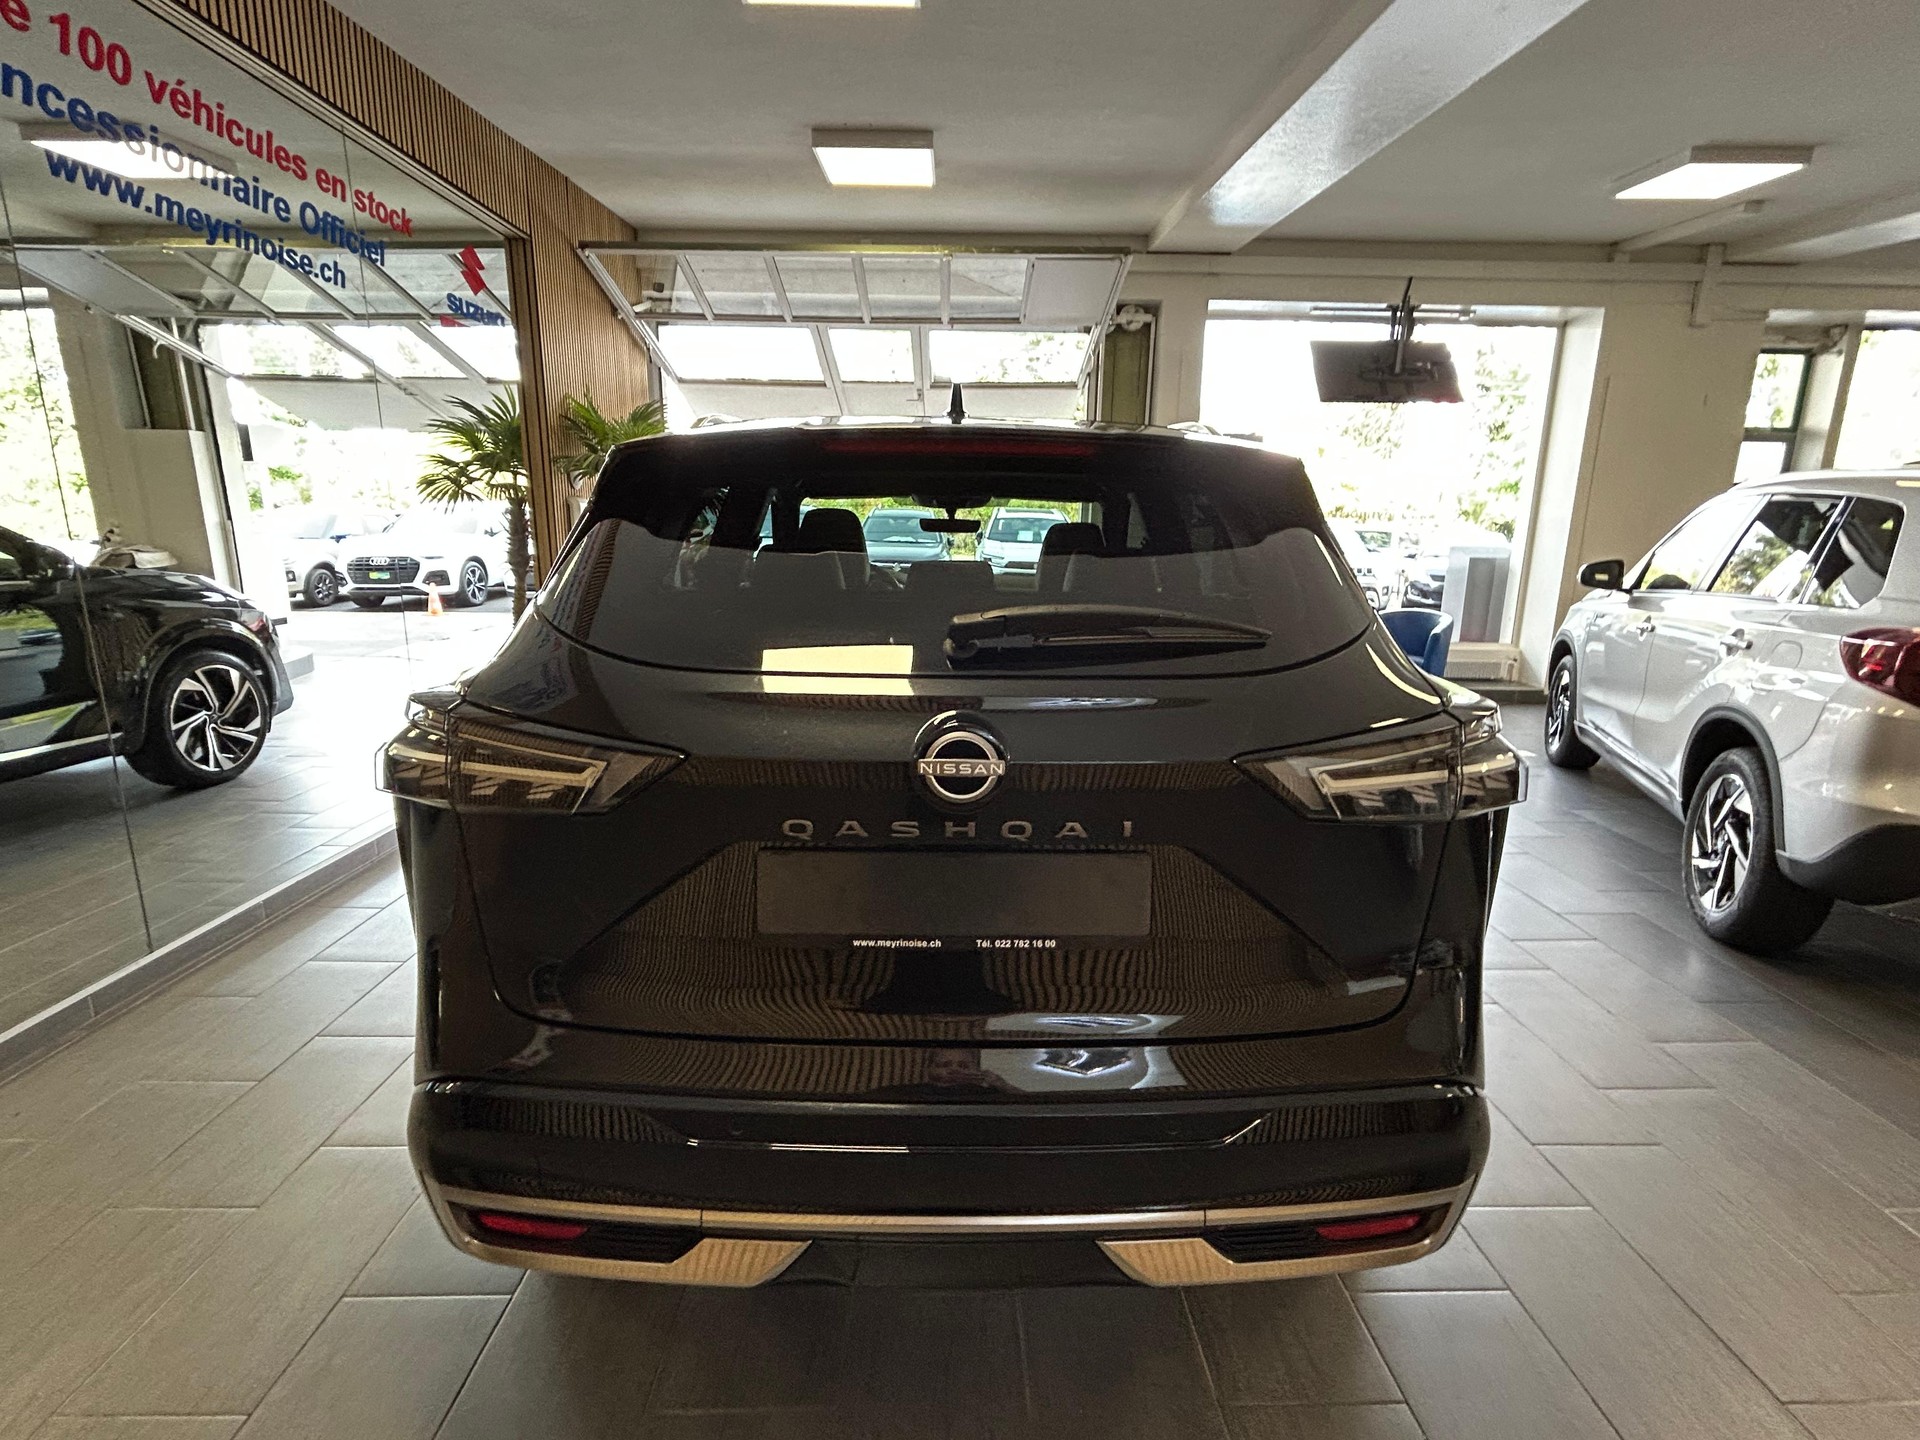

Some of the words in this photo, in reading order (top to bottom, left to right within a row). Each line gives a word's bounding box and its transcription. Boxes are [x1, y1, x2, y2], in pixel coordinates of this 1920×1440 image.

[49, 13, 132, 86] 100
[144, 70, 307, 181] véhicules
[315, 167, 346, 202] en
[354, 188, 413, 237] stock
[44, 149, 346, 288] www.meyrinoise.ch
[300, 201, 385, 267] Officiel
[920, 763, 1003, 775] NISSAN
[781, 818, 1133, 841] QASHQAI
[853, 939, 942, 949] www.meyrinoise.ch
[976, 939, 993, 948] Tél.
[995, 939, 1011, 948] 022
[1013, 939, 1030, 948] 782
[1032, 939, 1043, 948] 16
[1045, 939, 1056, 948] 00
